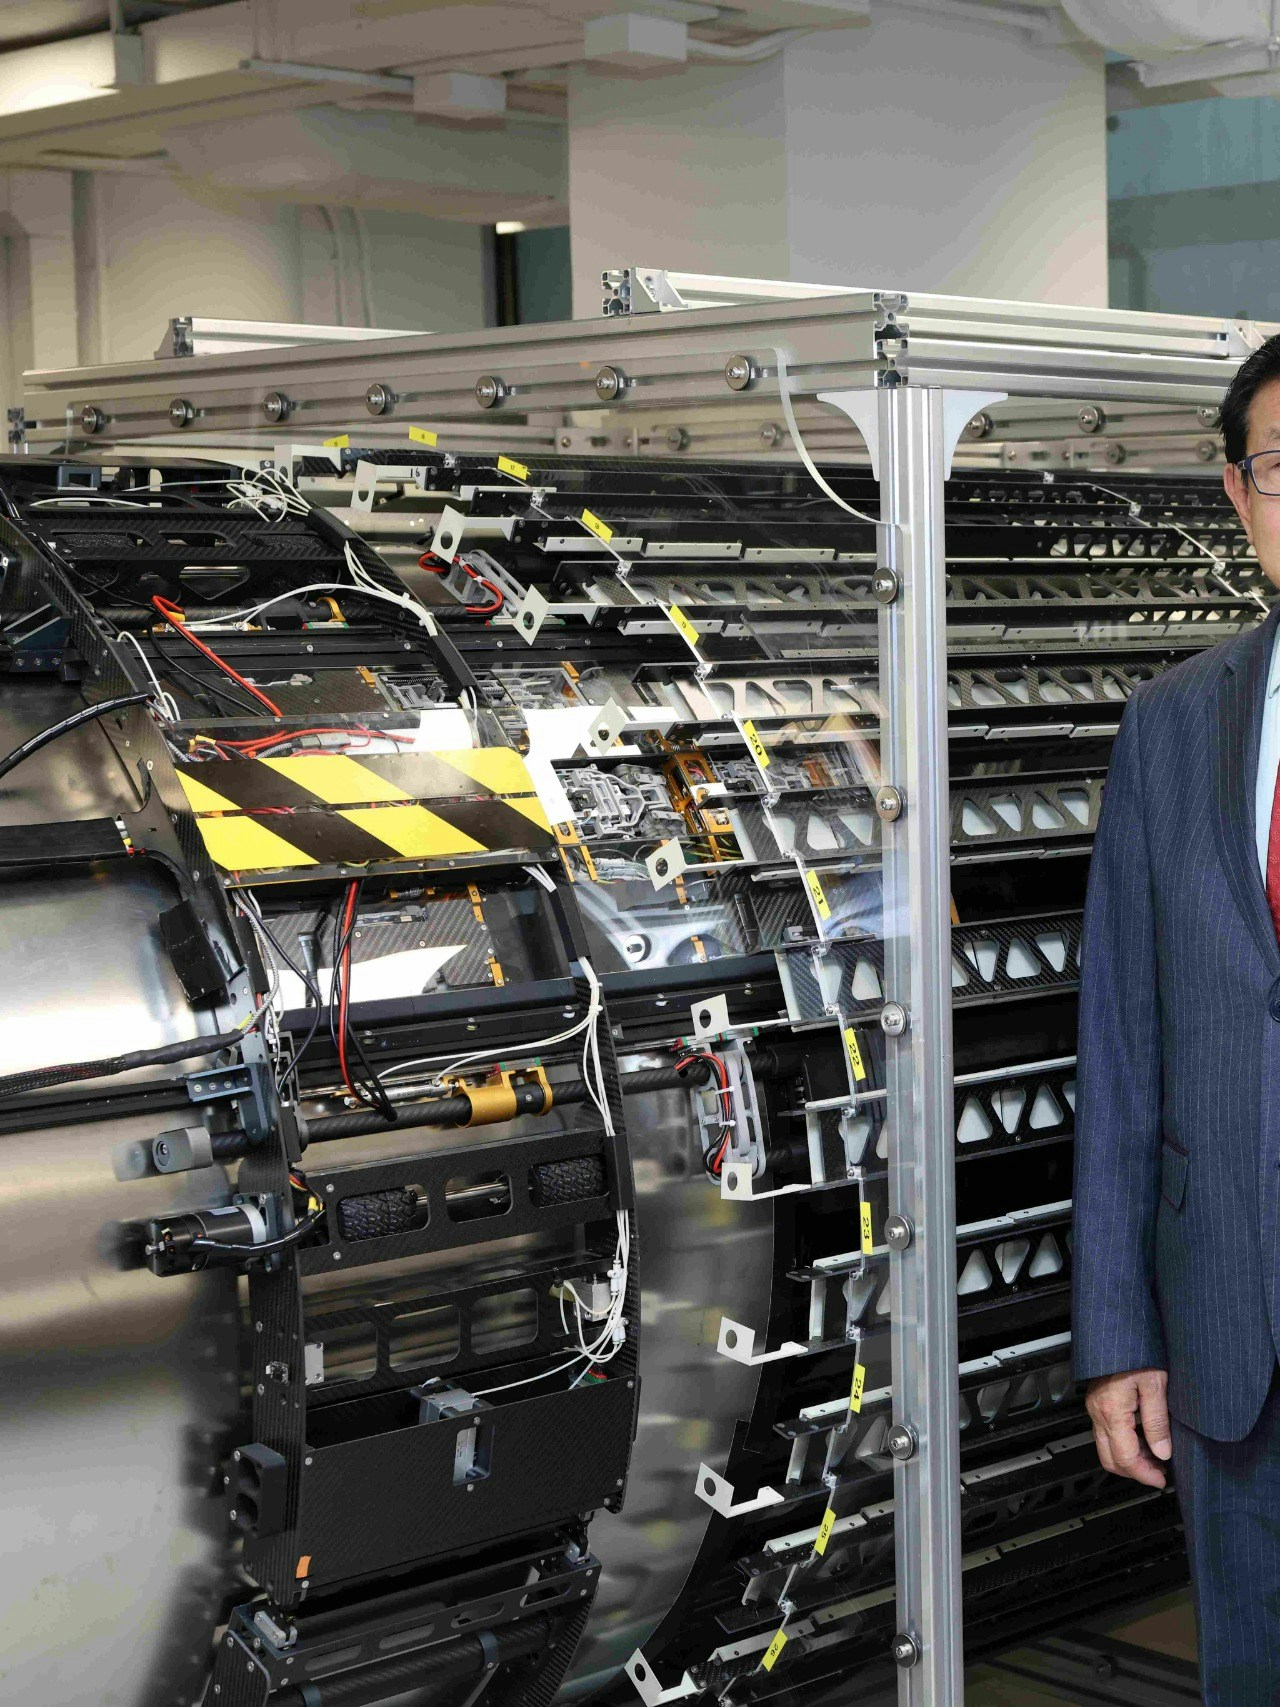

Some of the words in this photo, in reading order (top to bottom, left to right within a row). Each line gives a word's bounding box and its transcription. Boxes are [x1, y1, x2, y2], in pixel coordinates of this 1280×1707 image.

[750, 733, 762, 755] 20
[813, 885, 824, 905] 21
[849, 1042, 860, 1066] 22
[862, 1216, 870, 1240] 23
[854, 1377, 862, 1400] 24
[821, 1523, 829, 1539] 25
[770, 1643, 779, 1657] 26
